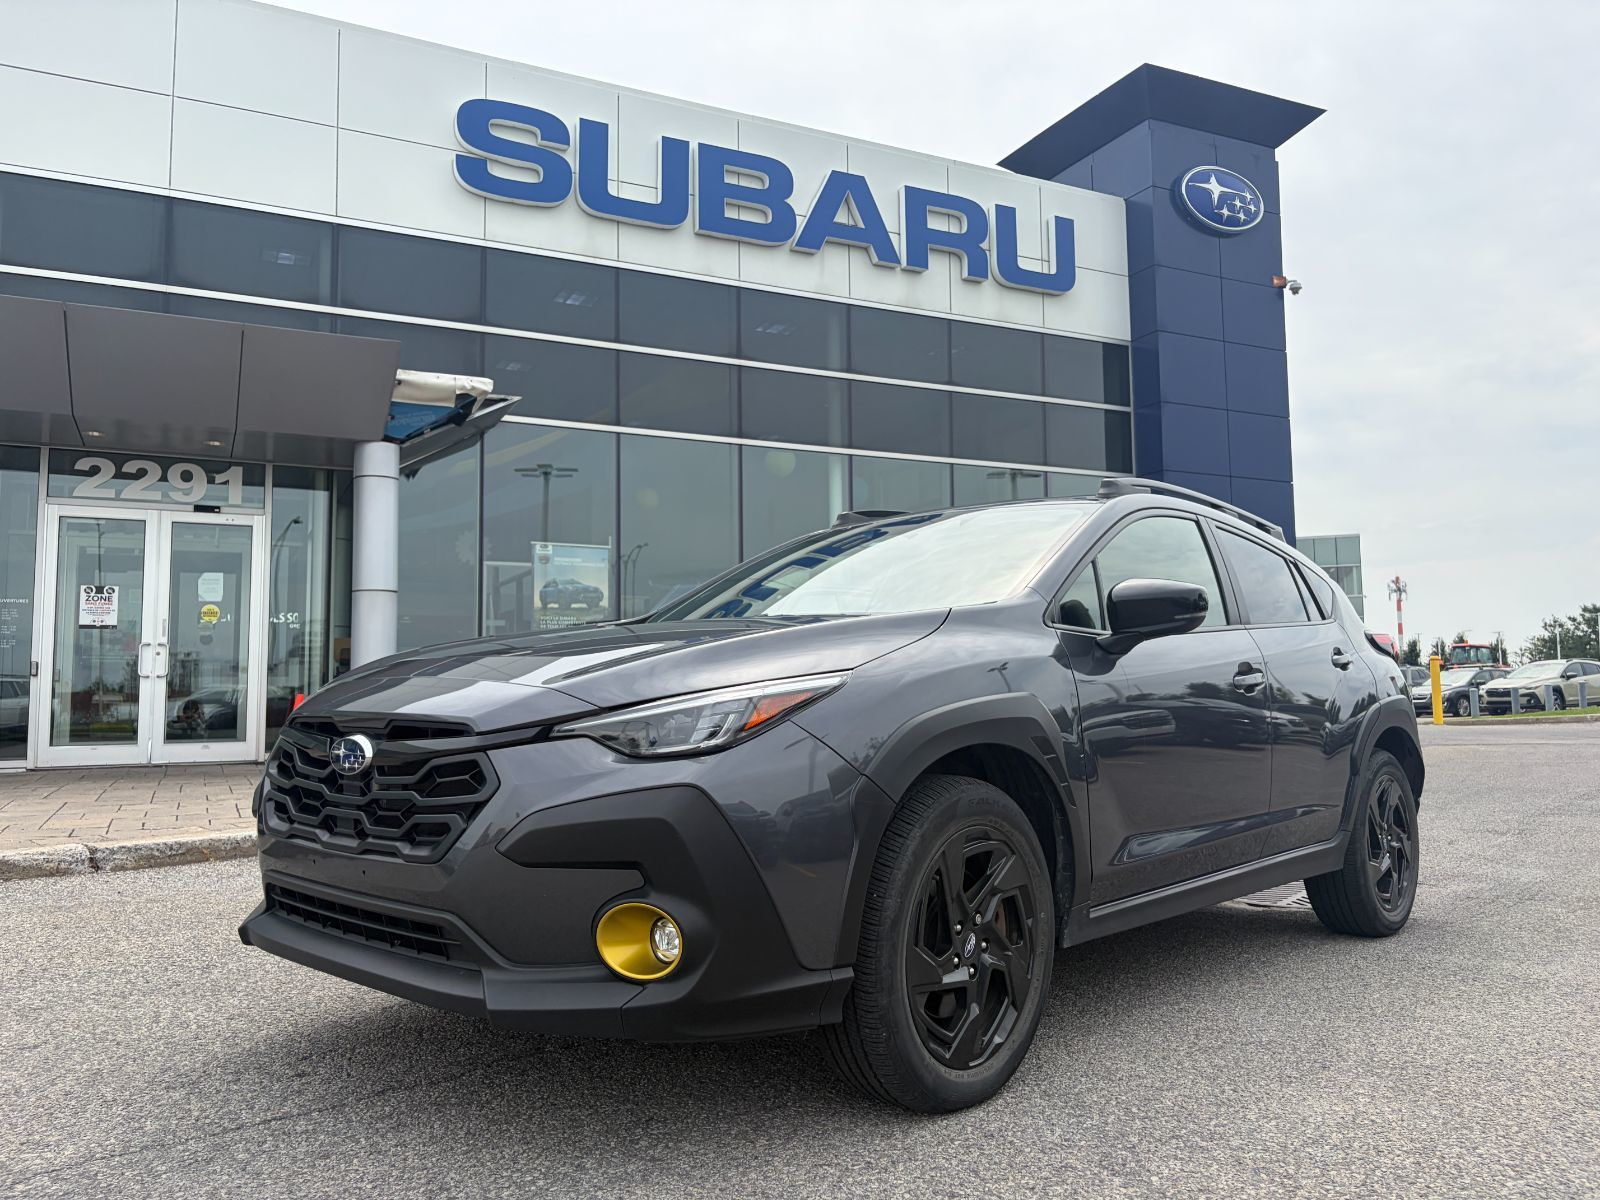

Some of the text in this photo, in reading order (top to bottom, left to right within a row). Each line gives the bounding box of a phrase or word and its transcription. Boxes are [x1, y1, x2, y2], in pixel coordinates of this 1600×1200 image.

[453, 97, 1076, 296] SUBARU
[72, 456, 243, 505] 2291
[85, 594, 113, 603] ZONE
